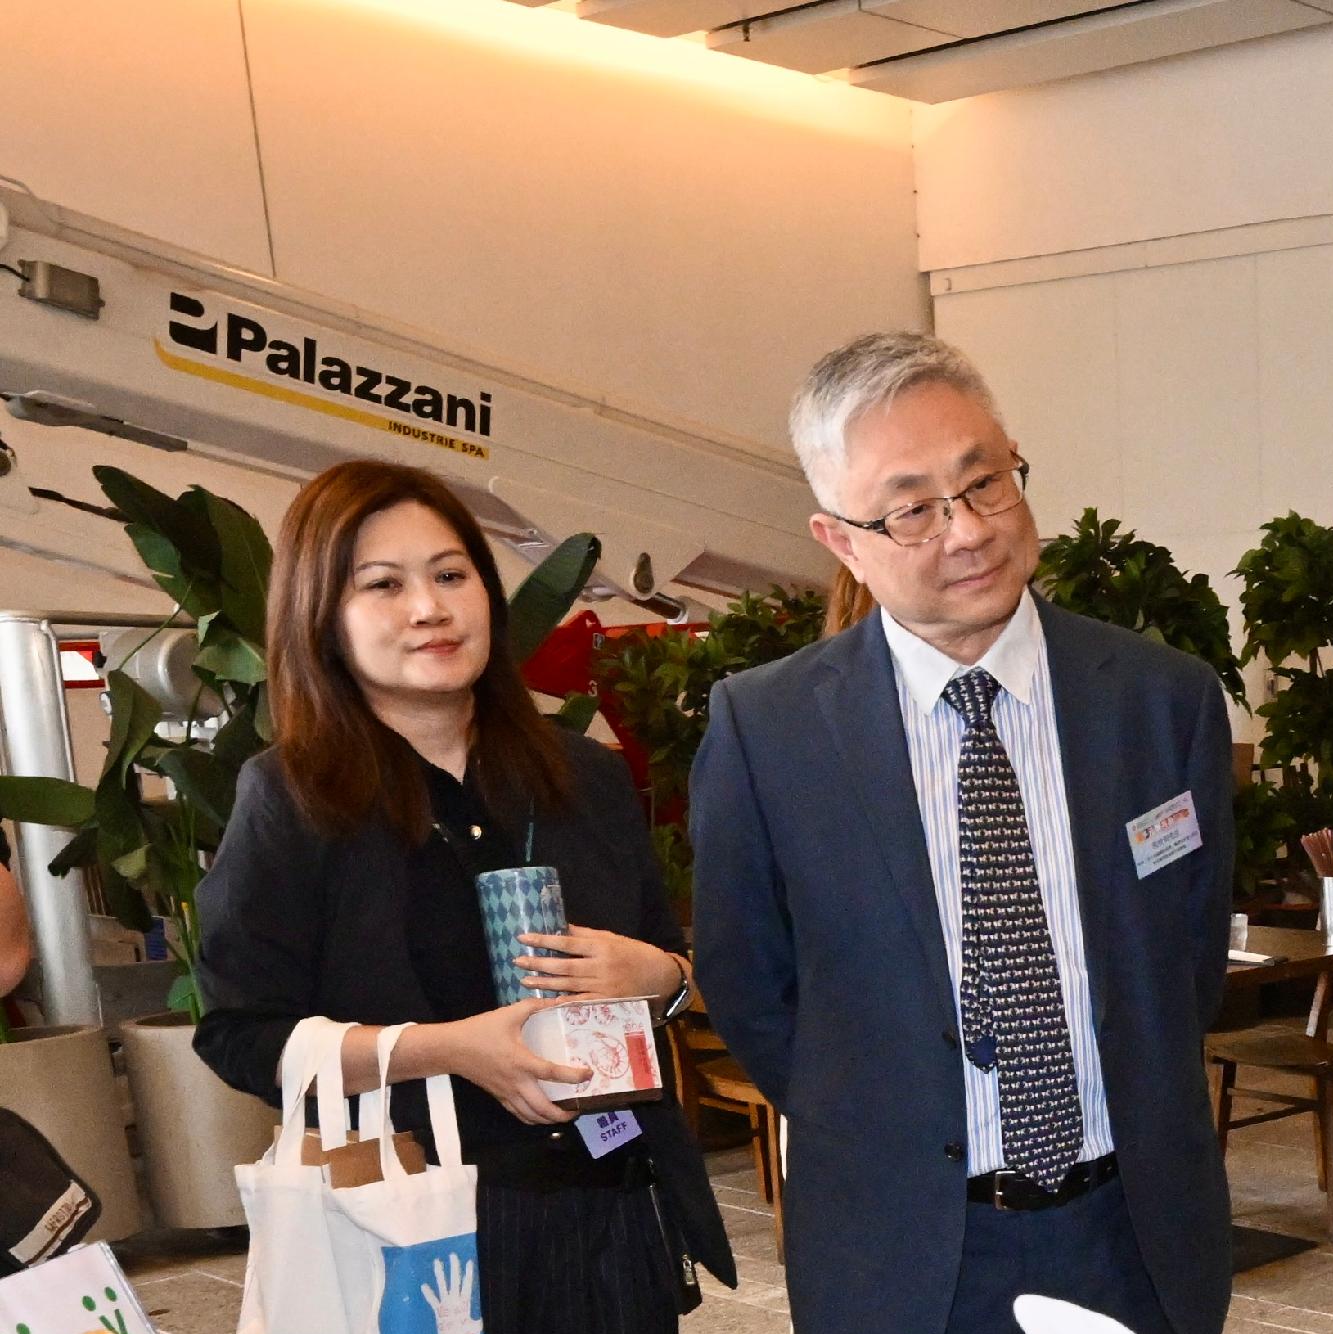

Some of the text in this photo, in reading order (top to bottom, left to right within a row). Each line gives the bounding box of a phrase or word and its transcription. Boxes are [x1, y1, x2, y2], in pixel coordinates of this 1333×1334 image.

[226, 312, 492, 437] Palazzani
[387, 421, 486, 458] INDUSTRIE SPA
[600, 1121, 628, 1142] STAFF
